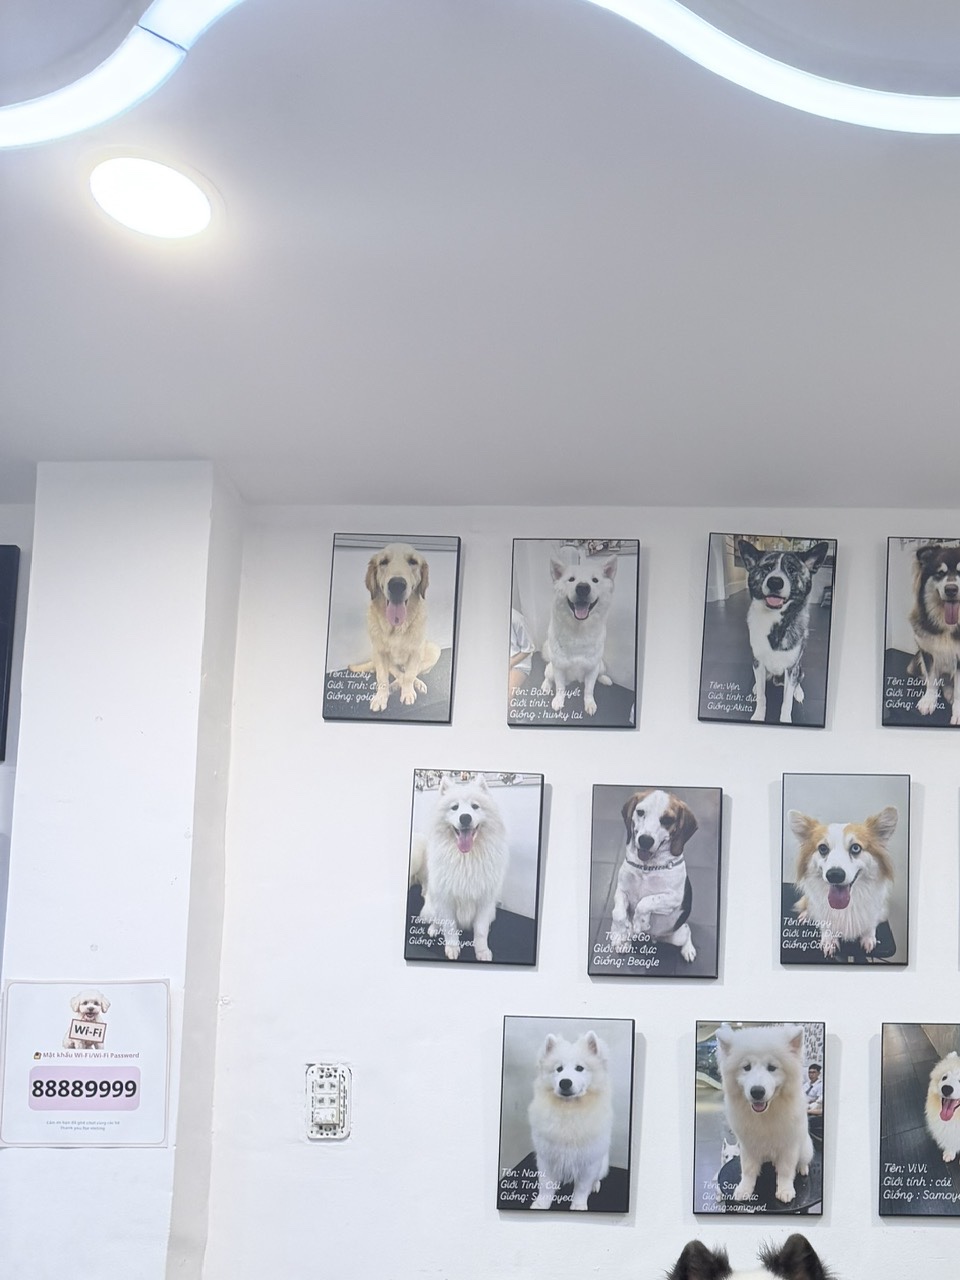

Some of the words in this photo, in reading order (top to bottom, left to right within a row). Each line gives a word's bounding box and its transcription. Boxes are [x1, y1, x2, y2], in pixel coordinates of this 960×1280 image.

[886, 677, 905, 686] Tên:
[326, 691, 354, 702] Giống:
[708, 692, 724, 700] Giới
[726, 693, 744, 701] tính:
[886, 688, 903, 696] Giới
[510, 699, 527, 707] Giới
[530, 699, 550, 707] tính:
[886, 700, 914, 710] Giống:
[510, 710, 536, 720] Giống
[543, 711, 568, 721] husky
[571, 711, 583, 719] lai
[410, 926, 426, 934] Giới
[782, 929, 799, 937] Giới
[409, 937, 436, 947] Giống:
[594, 944, 613, 953] Giới
[593, 954, 625, 968] Giống:
[628, 957, 660, 968] Beagle
[74, 1025, 102, 1038] Wi-Fi
[32, 1080, 137, 1098] 88889999
[502, 1168, 520, 1177] Tên:
[884, 1163, 905, 1173] Tên:
[908, 1164, 928, 1173] ViVi
[500, 1180, 518, 1188] Giới
[546, 1181, 561, 1189] Cái
[884, 1176, 903, 1186] Giới
[906, 1177, 926, 1186] tính
[936, 1178, 952, 1186] cái
[500, 1191, 528, 1203] Giống:
[884, 1188, 914, 1202] Giống
